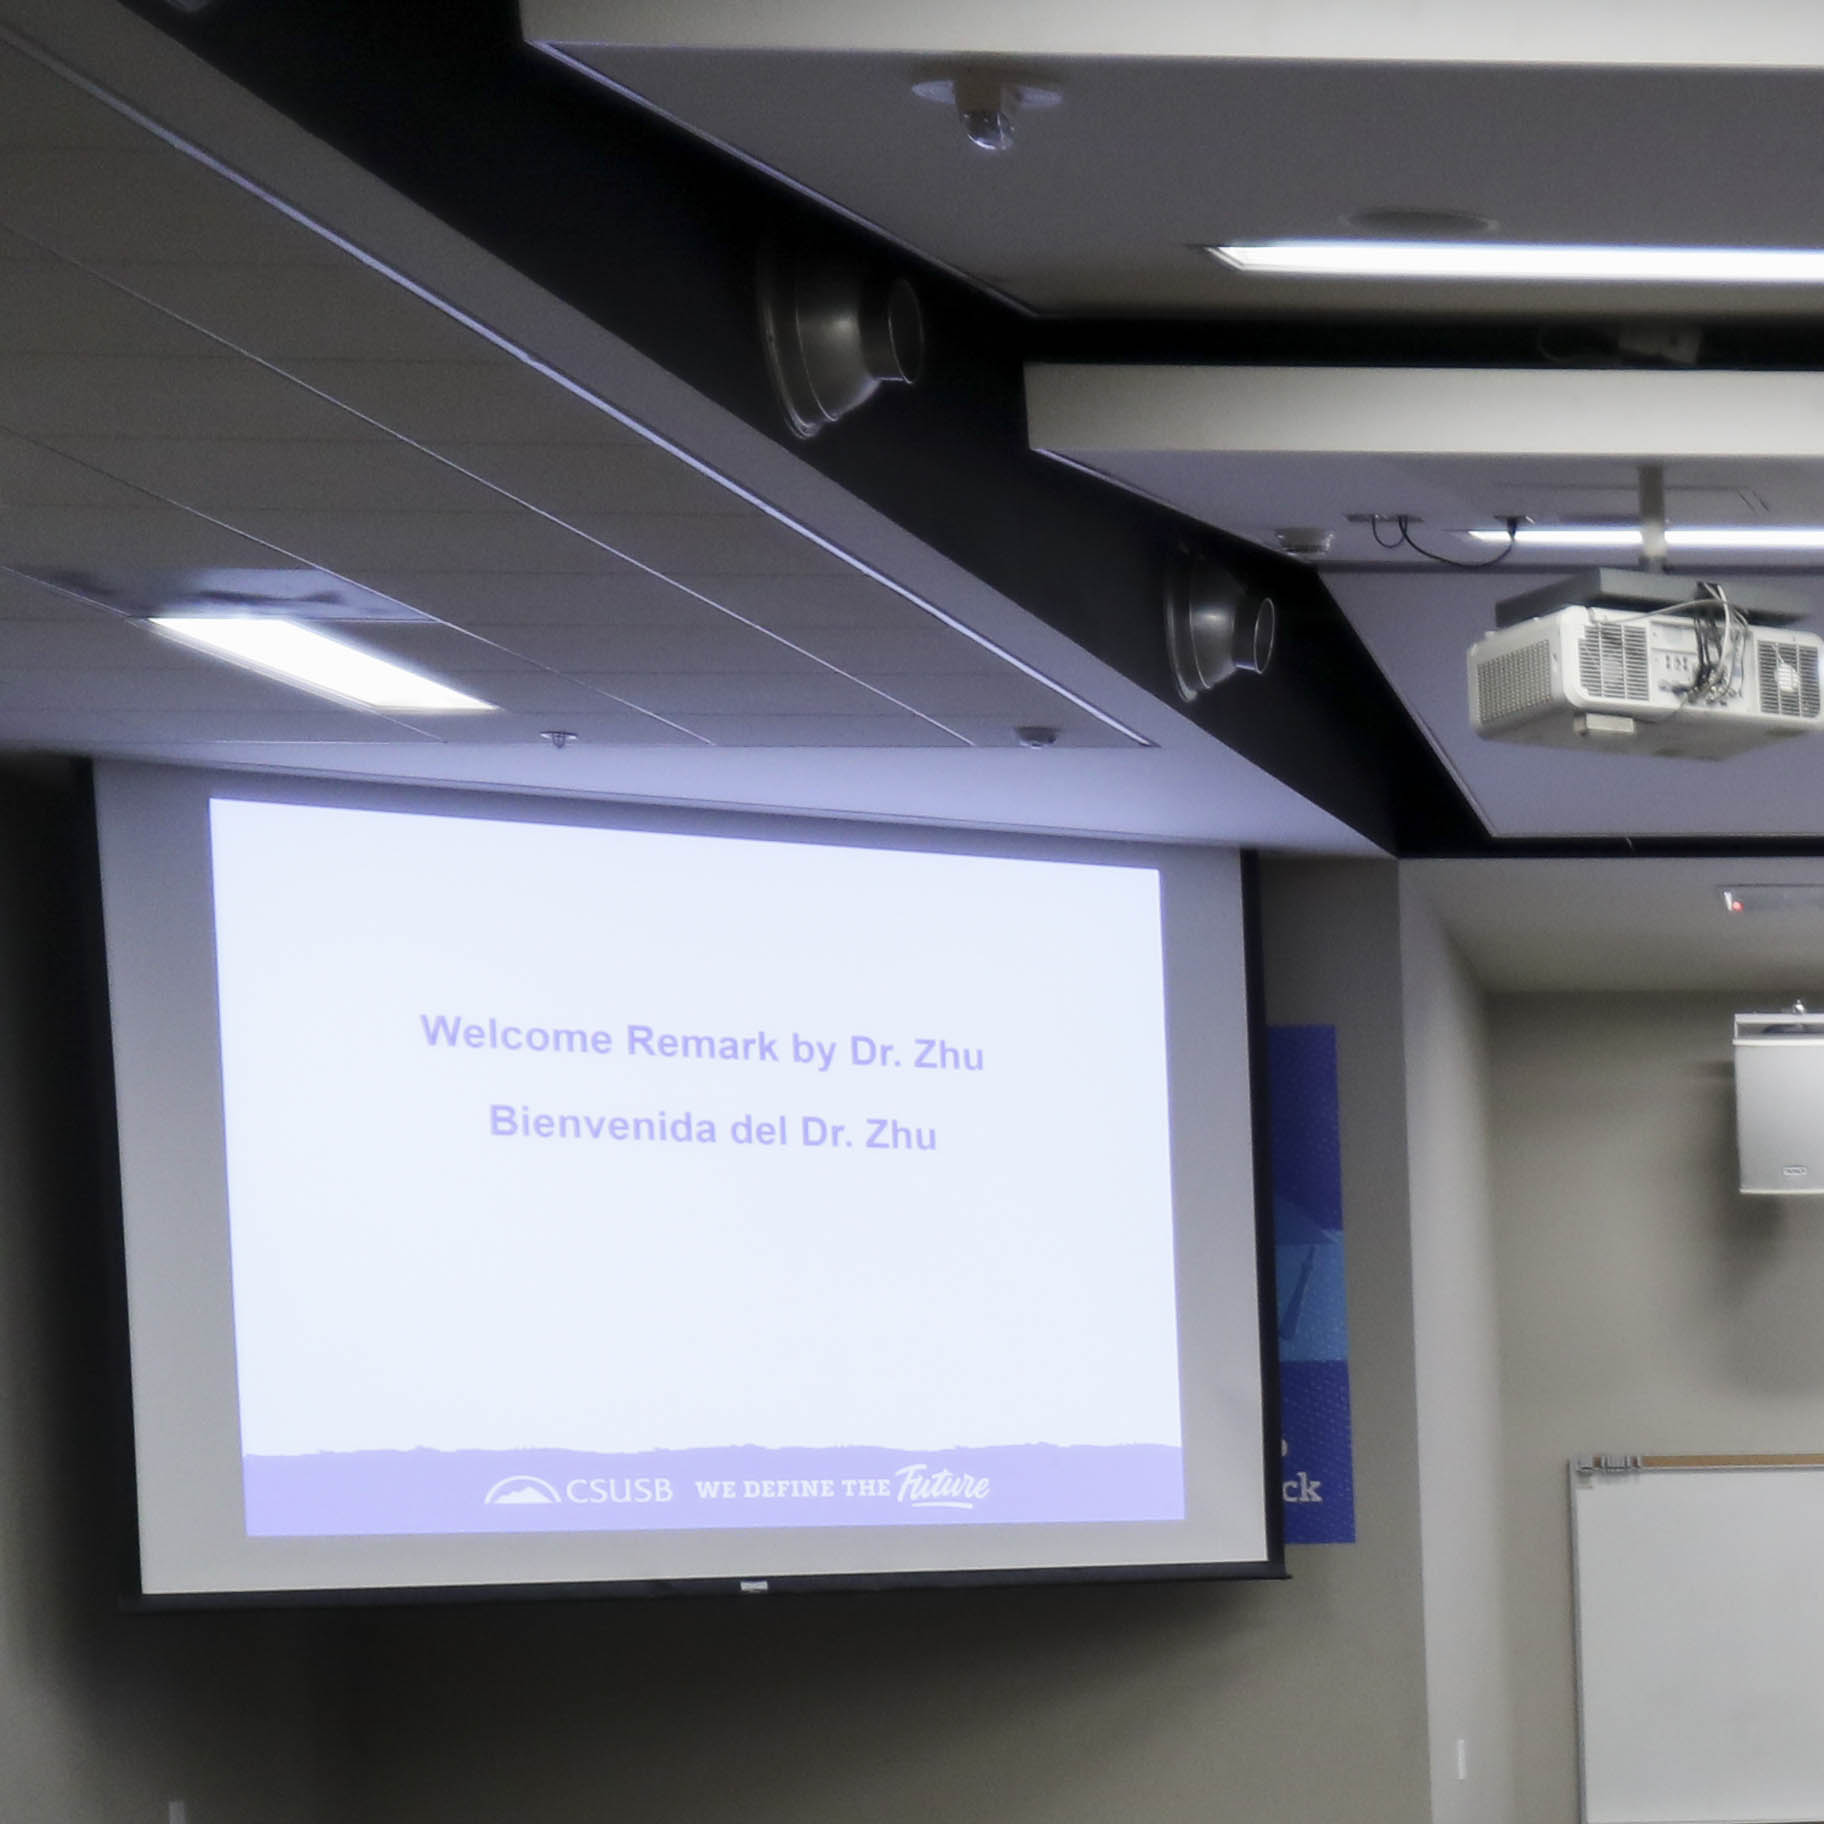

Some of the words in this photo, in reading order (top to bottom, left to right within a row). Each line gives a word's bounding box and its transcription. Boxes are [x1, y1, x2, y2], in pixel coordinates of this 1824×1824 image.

[420, 1011, 614, 1056] Welcome
[627, 1019, 781, 1064] Remark
[792, 1027, 839, 1074] by
[851, 1031, 903, 1069] Dr.
[915, 1036, 985, 1073] Zhu
[489, 1104, 718, 1146] Bienvenida
[730, 1113, 789, 1147] del
[802, 1115, 854, 1149] Dr.
[866, 1117, 938, 1153] Zhu
[566, 1478, 674, 1504] CSUSB
[695, 1481, 738, 1500] WE
[743, 1479, 836, 1499] DEFINE
[842, 1478, 892, 1498] THE
[894, 1463, 991, 1506] Future
[1282, 1471, 1323, 1503] ck
